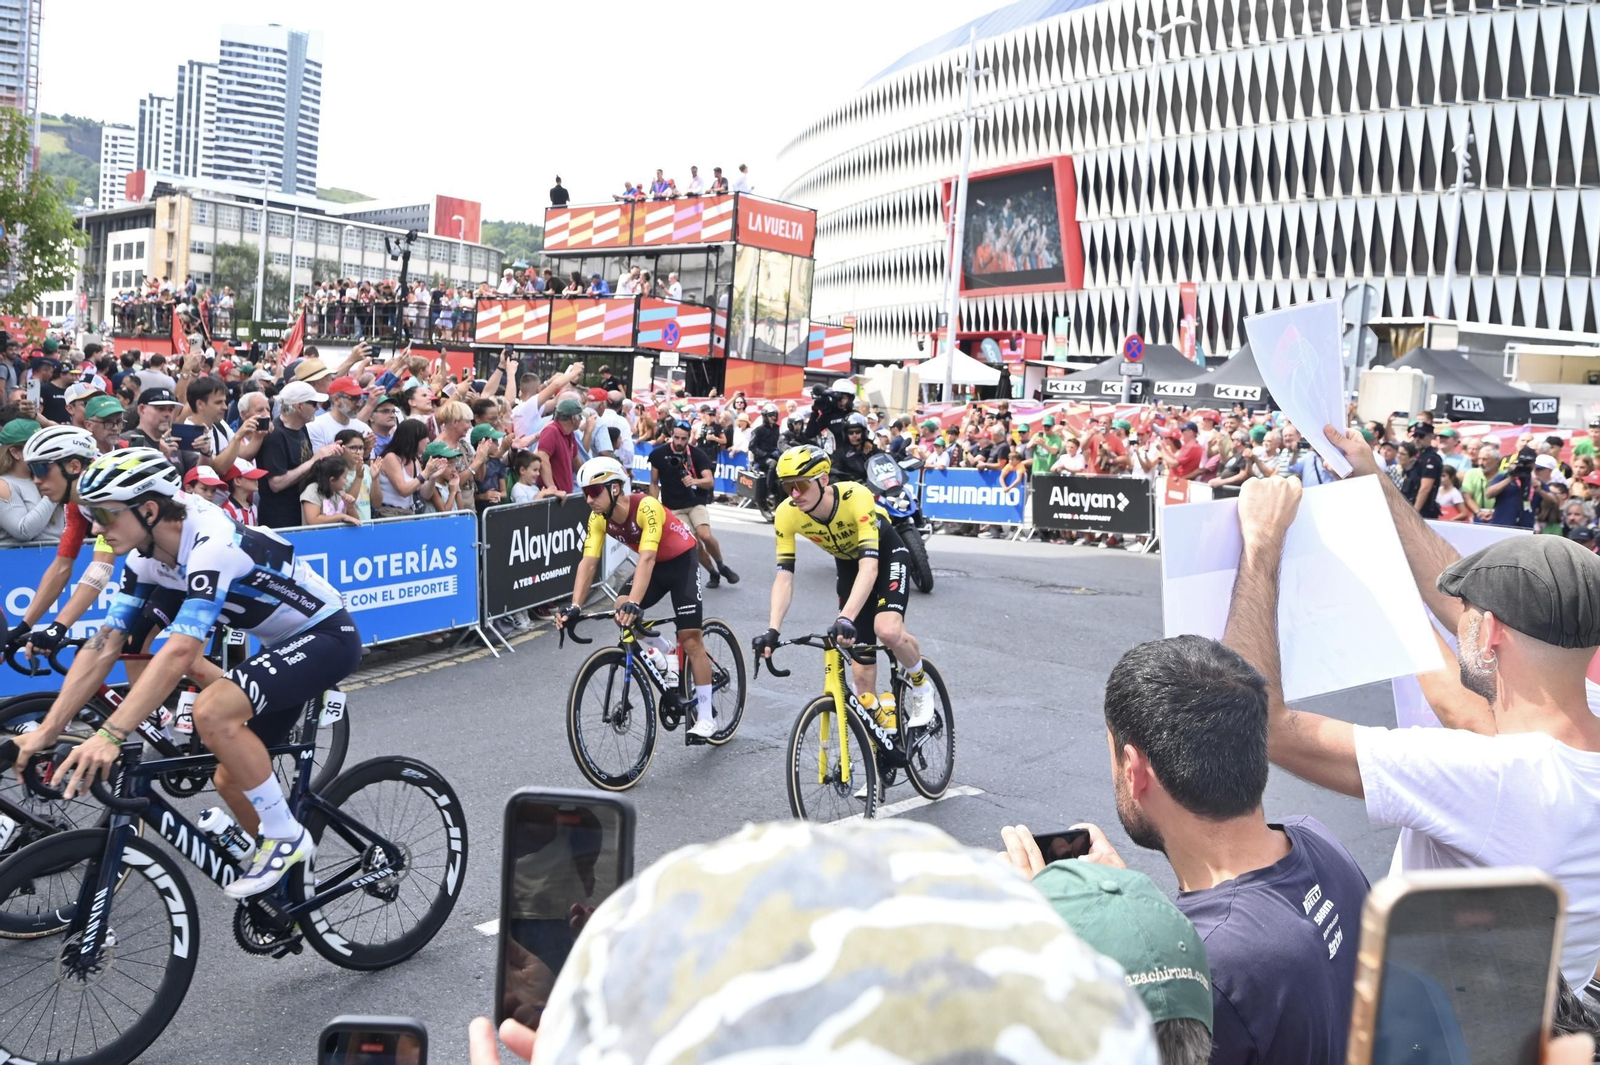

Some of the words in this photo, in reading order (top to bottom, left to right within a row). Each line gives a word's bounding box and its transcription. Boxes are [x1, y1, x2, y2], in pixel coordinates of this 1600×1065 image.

[748, 211, 762, 232] LA
[764, 215, 803, 241] VUELTA
[260, 327, 280, 338] PUNTO
[72, 439, 90, 449] uvex
[872, 462, 895, 476] rtve
[926, 485, 1020, 506] SHIMANO
[1049, 486, 1115, 512] Alayan
[1079, 514, 1112, 522] COMPANY
[508, 526, 575, 566] Alayan
[340, 543, 458, 584] LOTERÍAS
[190, 574, 213, 595] O2
[513, 580, 519, 590] A
[540, 565, 572, 582] COMPANY
[266, 580, 300, 602] Telefónica
[298, 594, 317, 611] Tech
[350, 592, 378, 606] CON
[382, 590, 395, 602] EL
[398, 580, 450, 600] DEPORTE
[272, 634, 316, 657] Telefónica
[282, 652, 307, 666] Tech
[640, 650, 671, 692] LOOK
[325, 701, 342, 718] 36
[352, 867, 394, 888] CANYON
[80, 886, 109, 955] CANYON
[1313, 899, 1335, 927] SRAM
